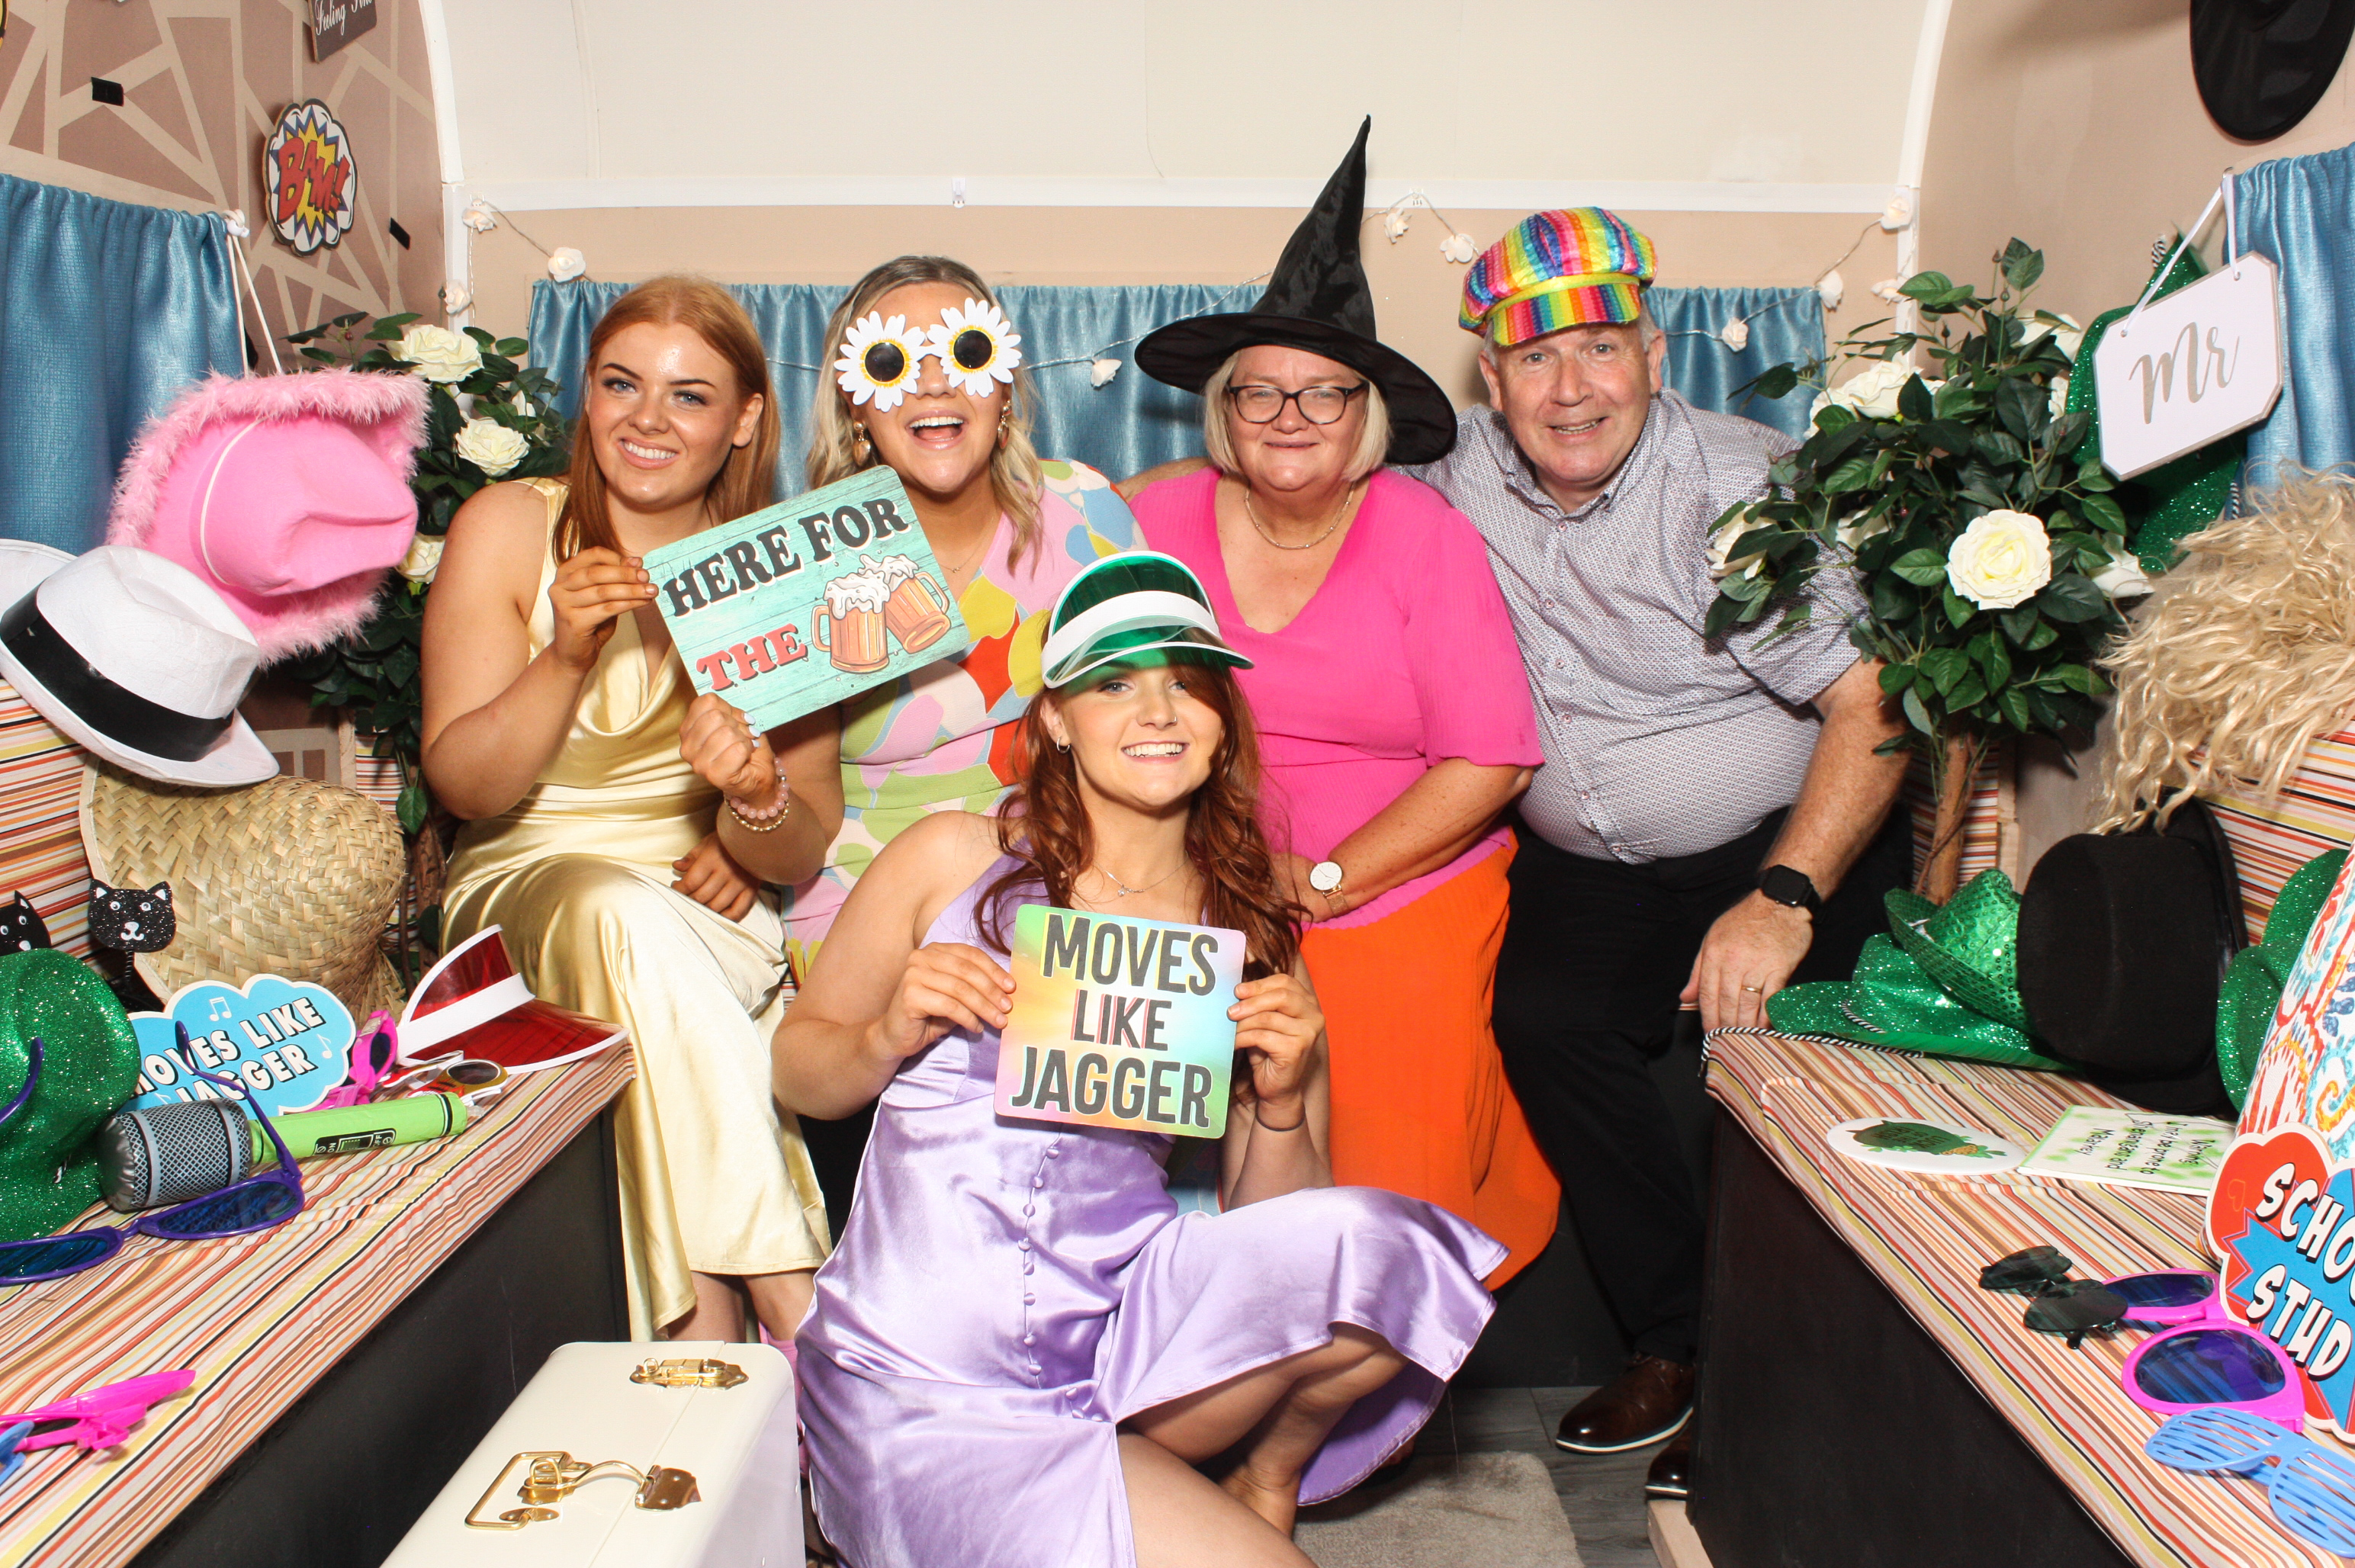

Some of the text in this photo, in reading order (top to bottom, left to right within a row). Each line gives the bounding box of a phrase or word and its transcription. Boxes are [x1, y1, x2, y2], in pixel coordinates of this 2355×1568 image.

[277, 137, 351, 223] BAM!
[2128, 321, 2241, 425] Mr
[662, 498, 911, 618] HERE FOR
[696, 622, 808, 692] THE
[1039, 912, 1219, 996] MOVES
[239, 996, 326, 1049] LIKE
[1070, 988, 1172, 1052] LIKE
[1008, 1045, 1213, 1129] JAGGER
[327, 1142, 337, 1153] ON
[2074, 1128, 2116, 1155] Malarkey
[2105, 1157, 2128, 1171] and
[2145, 1147, 2170, 1167] prone
[2157, 1139, 2178, 1148] be
[2255, 1162, 2355, 1306] SCHO
[2245, 1263, 2353, 1382] STUD
